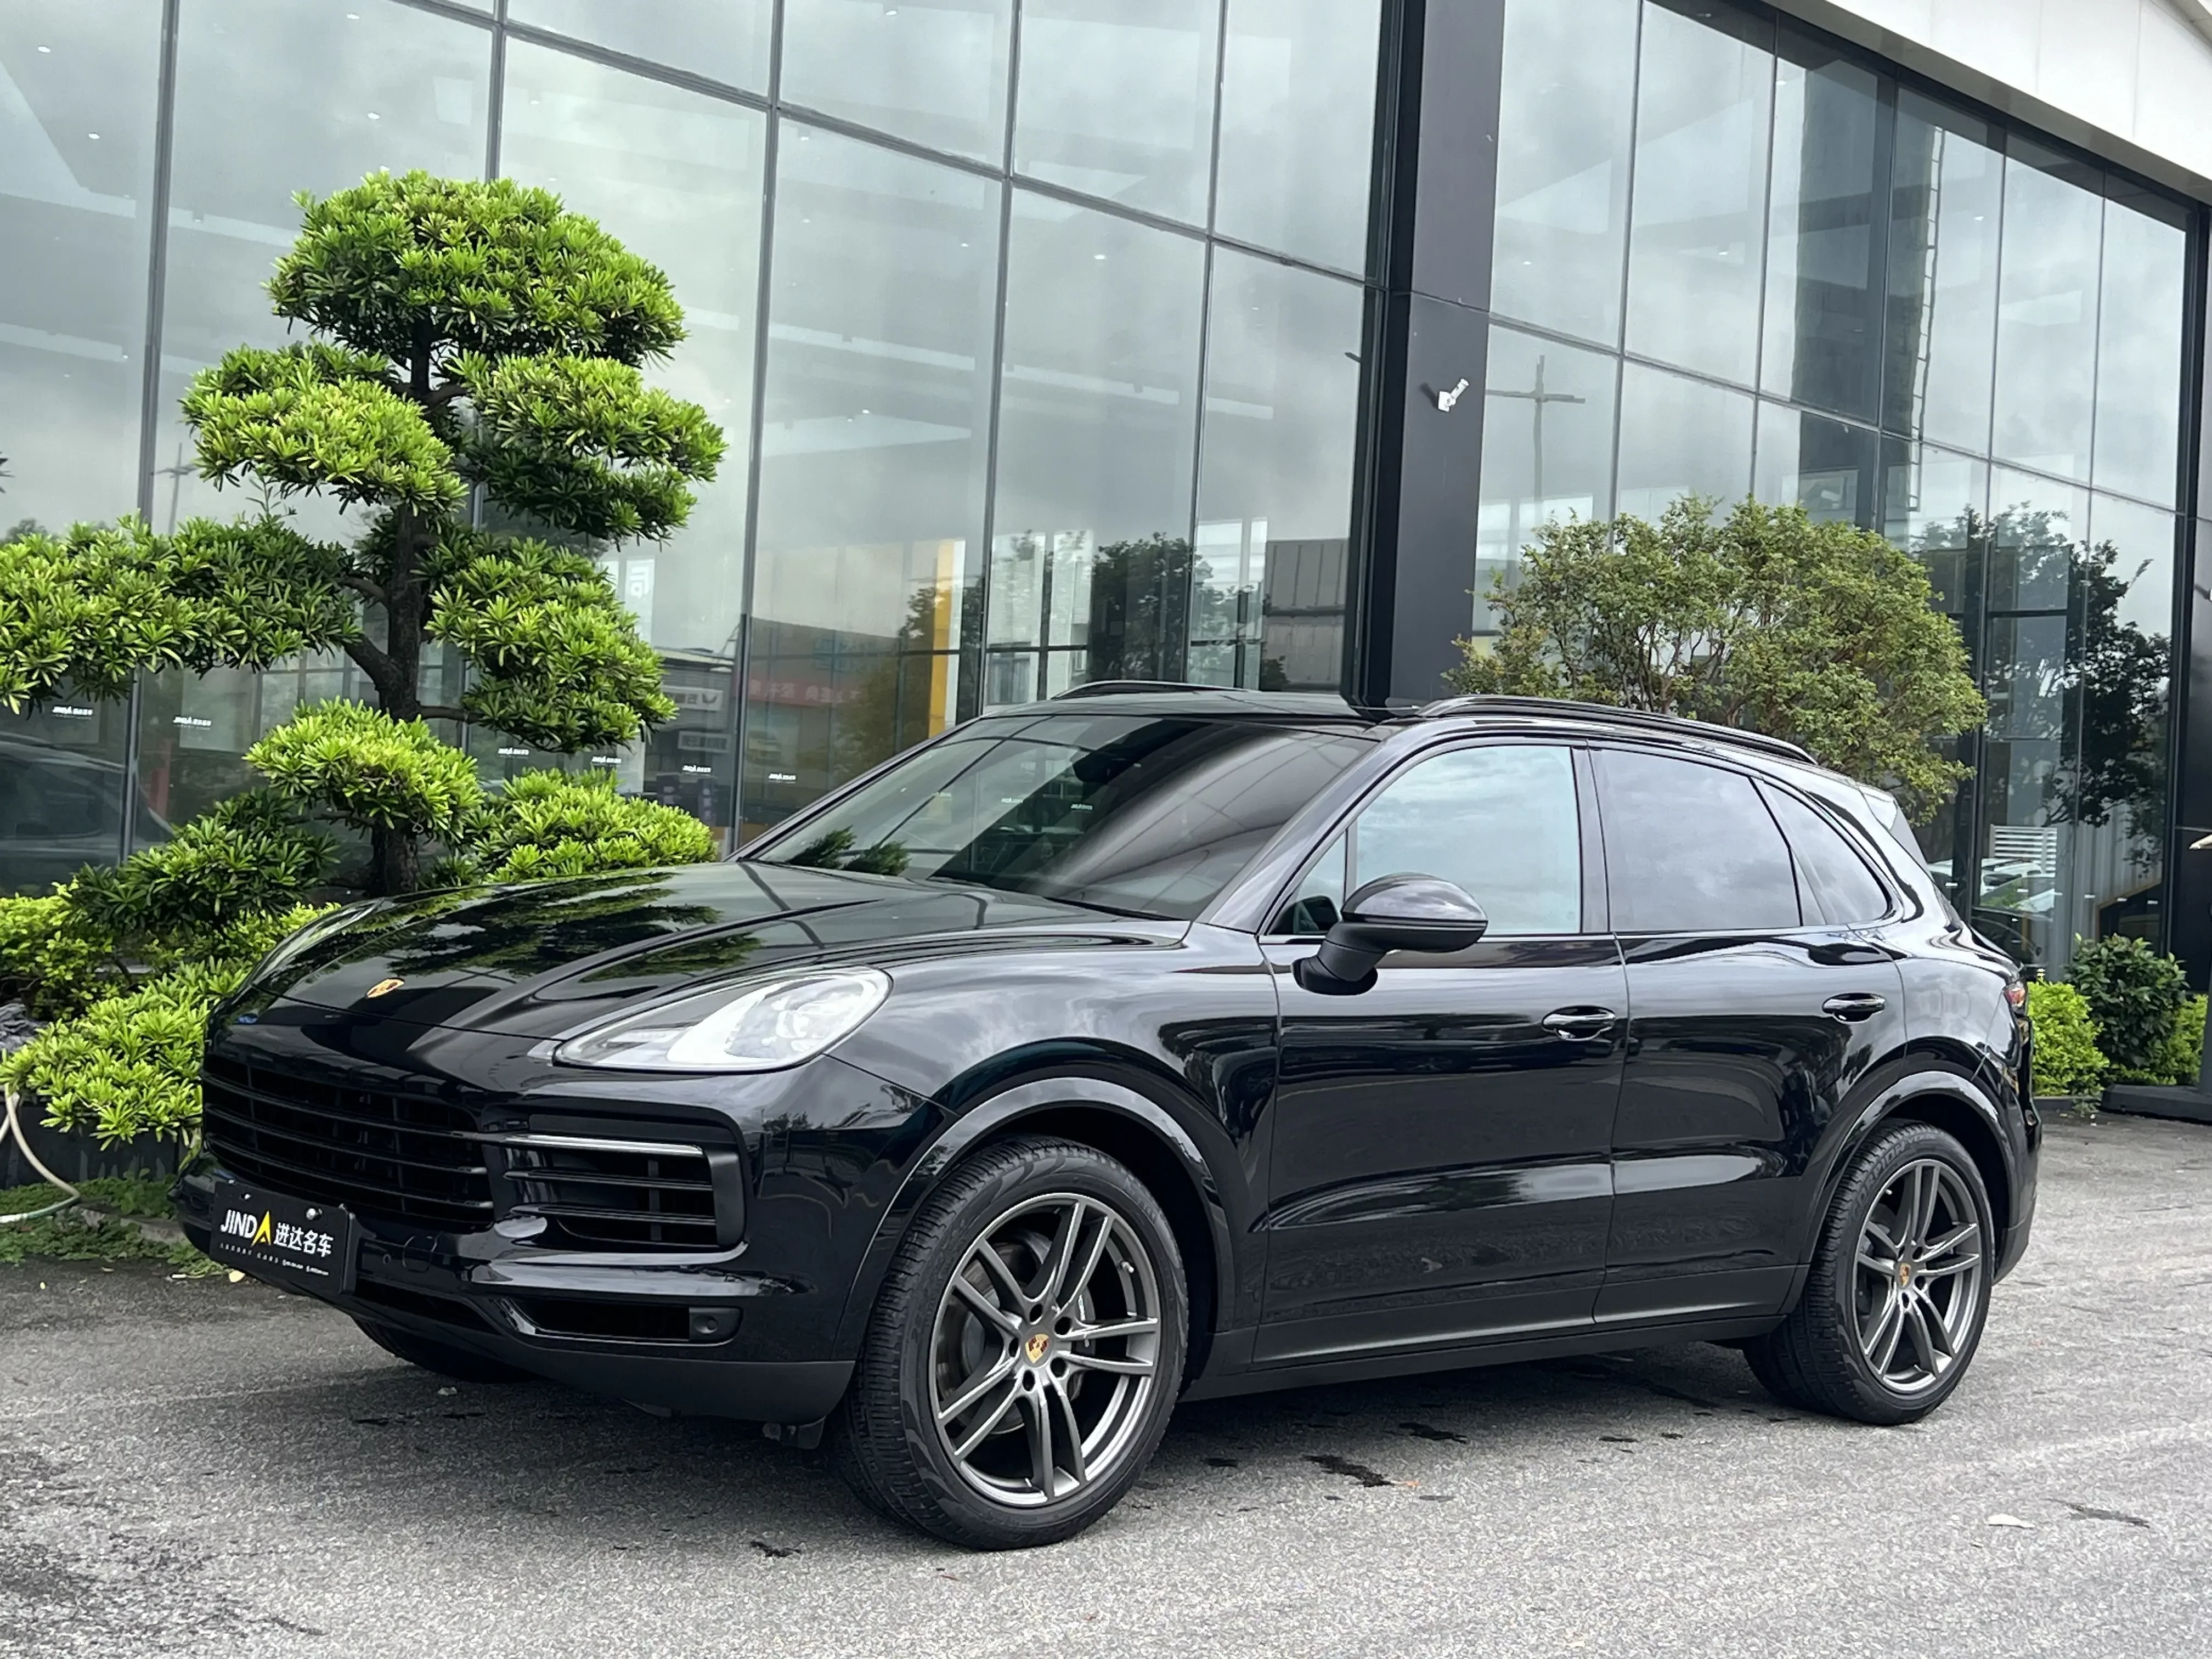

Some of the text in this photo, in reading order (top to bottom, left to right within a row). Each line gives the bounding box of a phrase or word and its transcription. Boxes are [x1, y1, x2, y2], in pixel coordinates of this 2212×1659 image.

[220, 1209, 271, 1247] JINDA
[273, 1222, 334, 1257] 进达名车
